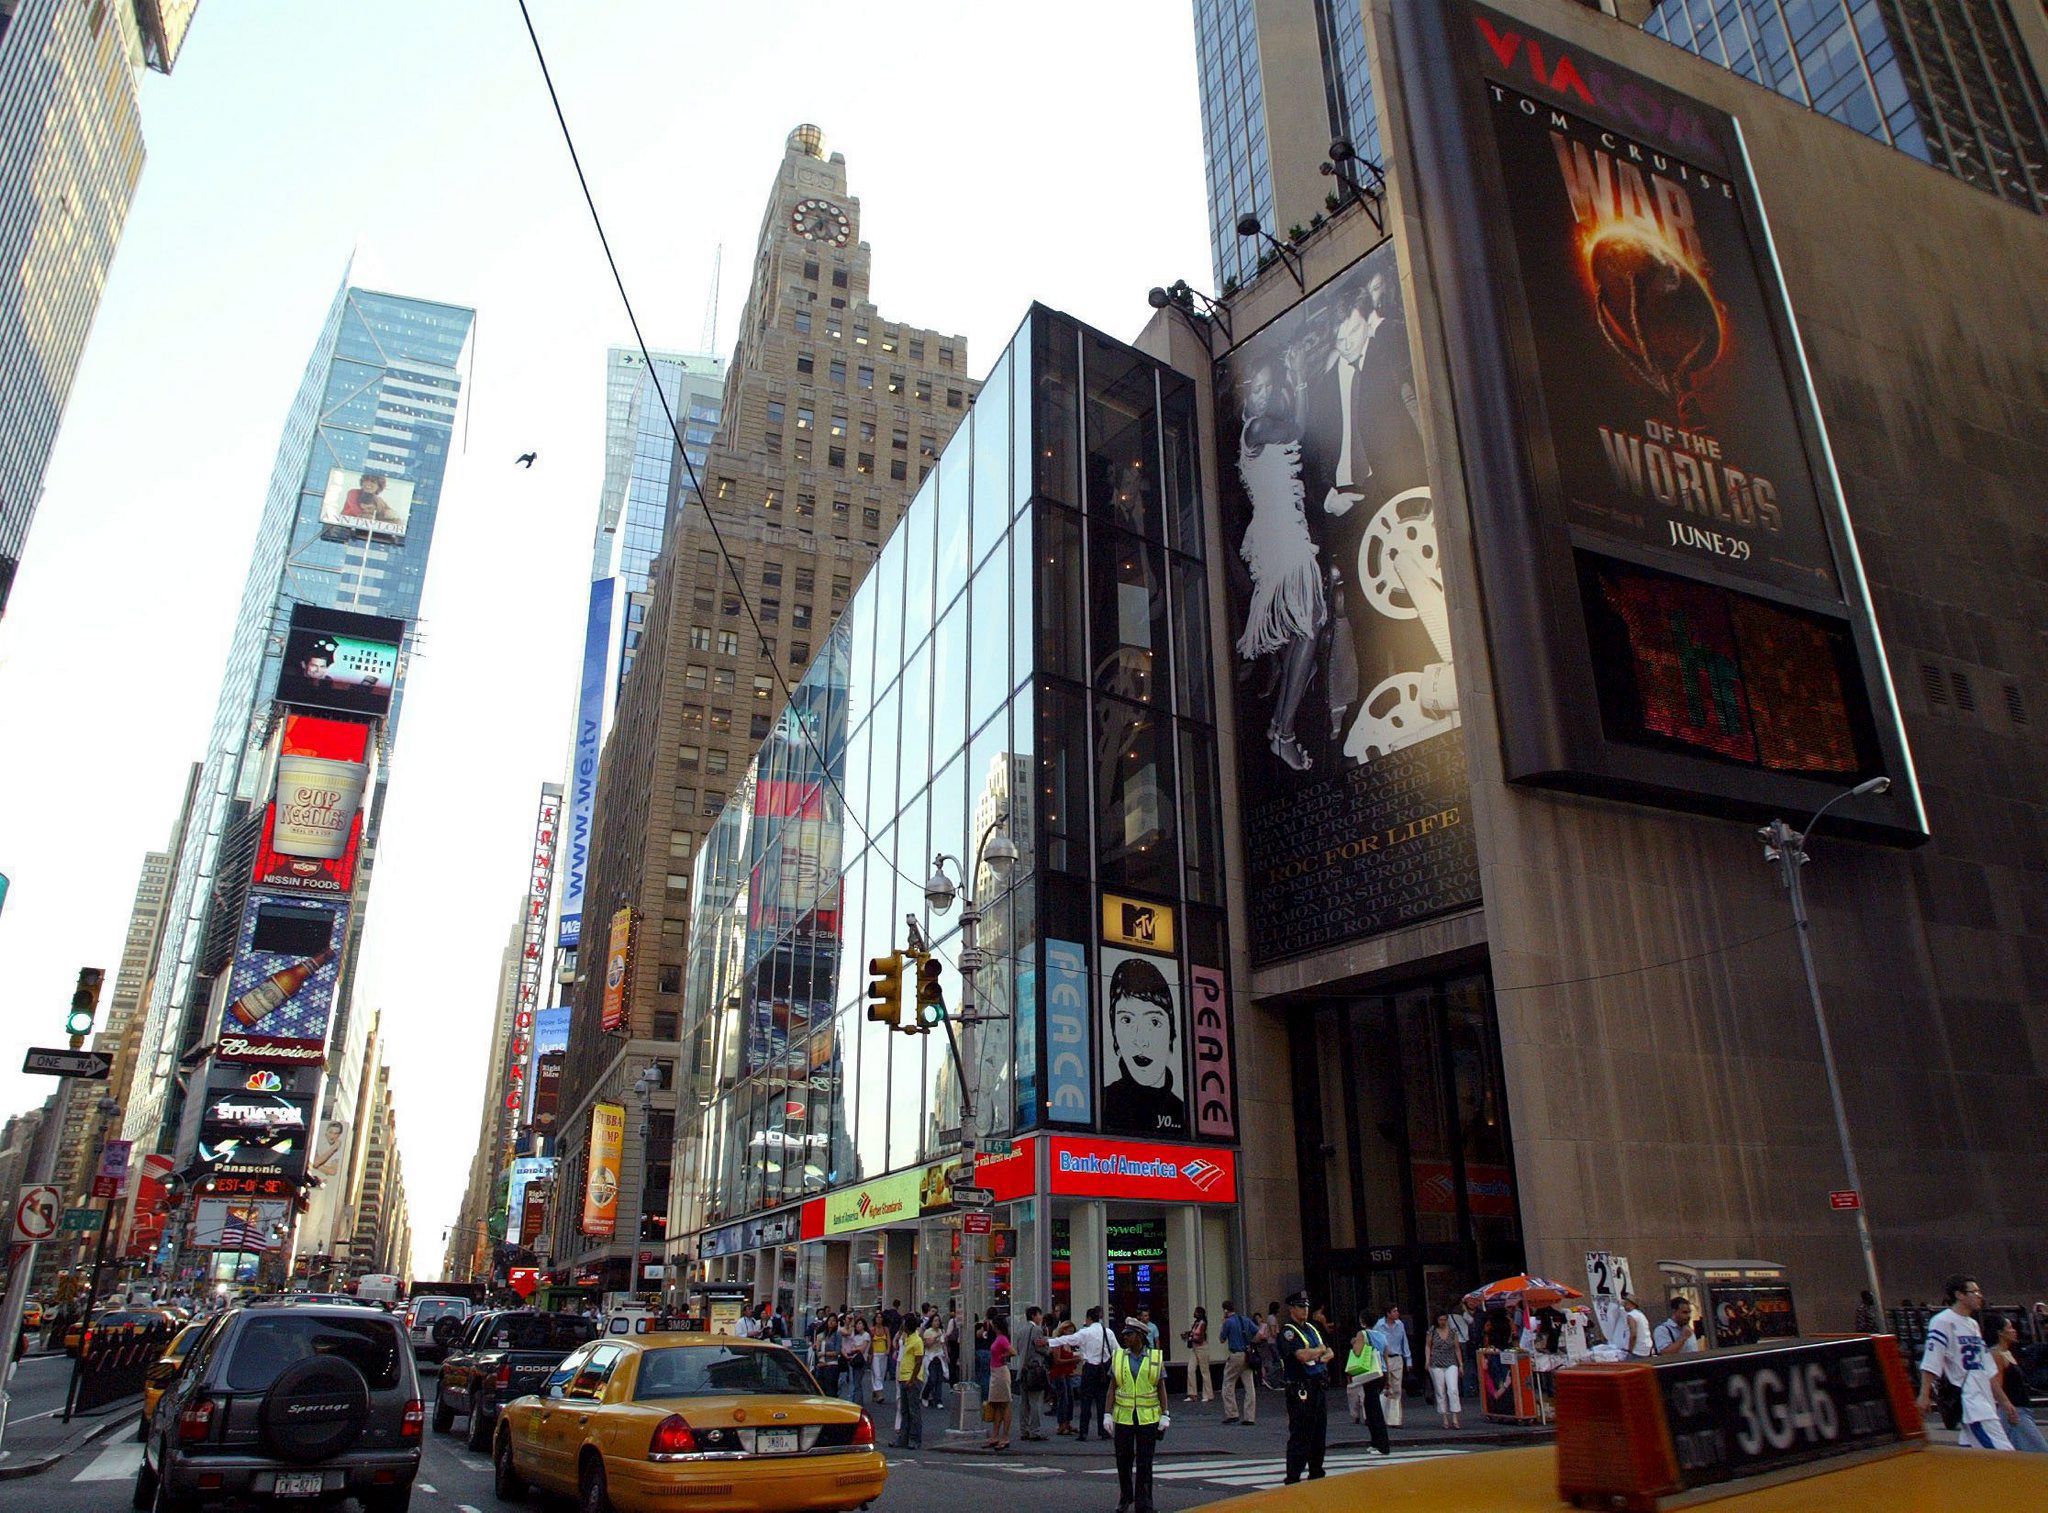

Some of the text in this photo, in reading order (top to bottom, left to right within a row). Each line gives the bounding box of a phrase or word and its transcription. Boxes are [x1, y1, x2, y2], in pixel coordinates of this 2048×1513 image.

[1490, 85, 1733, 199] TOM CRUISE
[1549, 130, 1698, 262] WAR
[1645, 418, 1722, 460] OF THE
[1599, 426, 1782, 533] WORLDS
[1666, 519, 1751, 562] JUNE 29
[360, 649, 378, 658] THE
[294, 786, 342, 810] CUP
[568, 718, 598, 899] www.we.tv
[281, 803, 350, 831] NOODLES
[1269, 805, 1459, 885] ROC FOR LIFE
[263, 874, 341, 890] NISSIN FOODS
[1121, 902, 1160, 940] MTV
[1051, 948, 1086, 1111] PEACE
[219, 1038, 324, 1059] Budweiser
[1194, 975, 1229, 1124] PEACE
[36, 1056, 101, 1071] ONE WAY
[217, 1103, 302, 1122] SITUATION
[994, 1141, 1003, 1152] 45
[214, 1163, 283, 1174] Panasonic
[1059, 1151, 1178, 1179] Bank of America
[958, 1192, 970, 1201] ONE
[667, 1319, 691, 1330] 3M80
[287, 1402, 350, 1414] Sportage
[1727, 1361, 1841, 1458] 3G46
